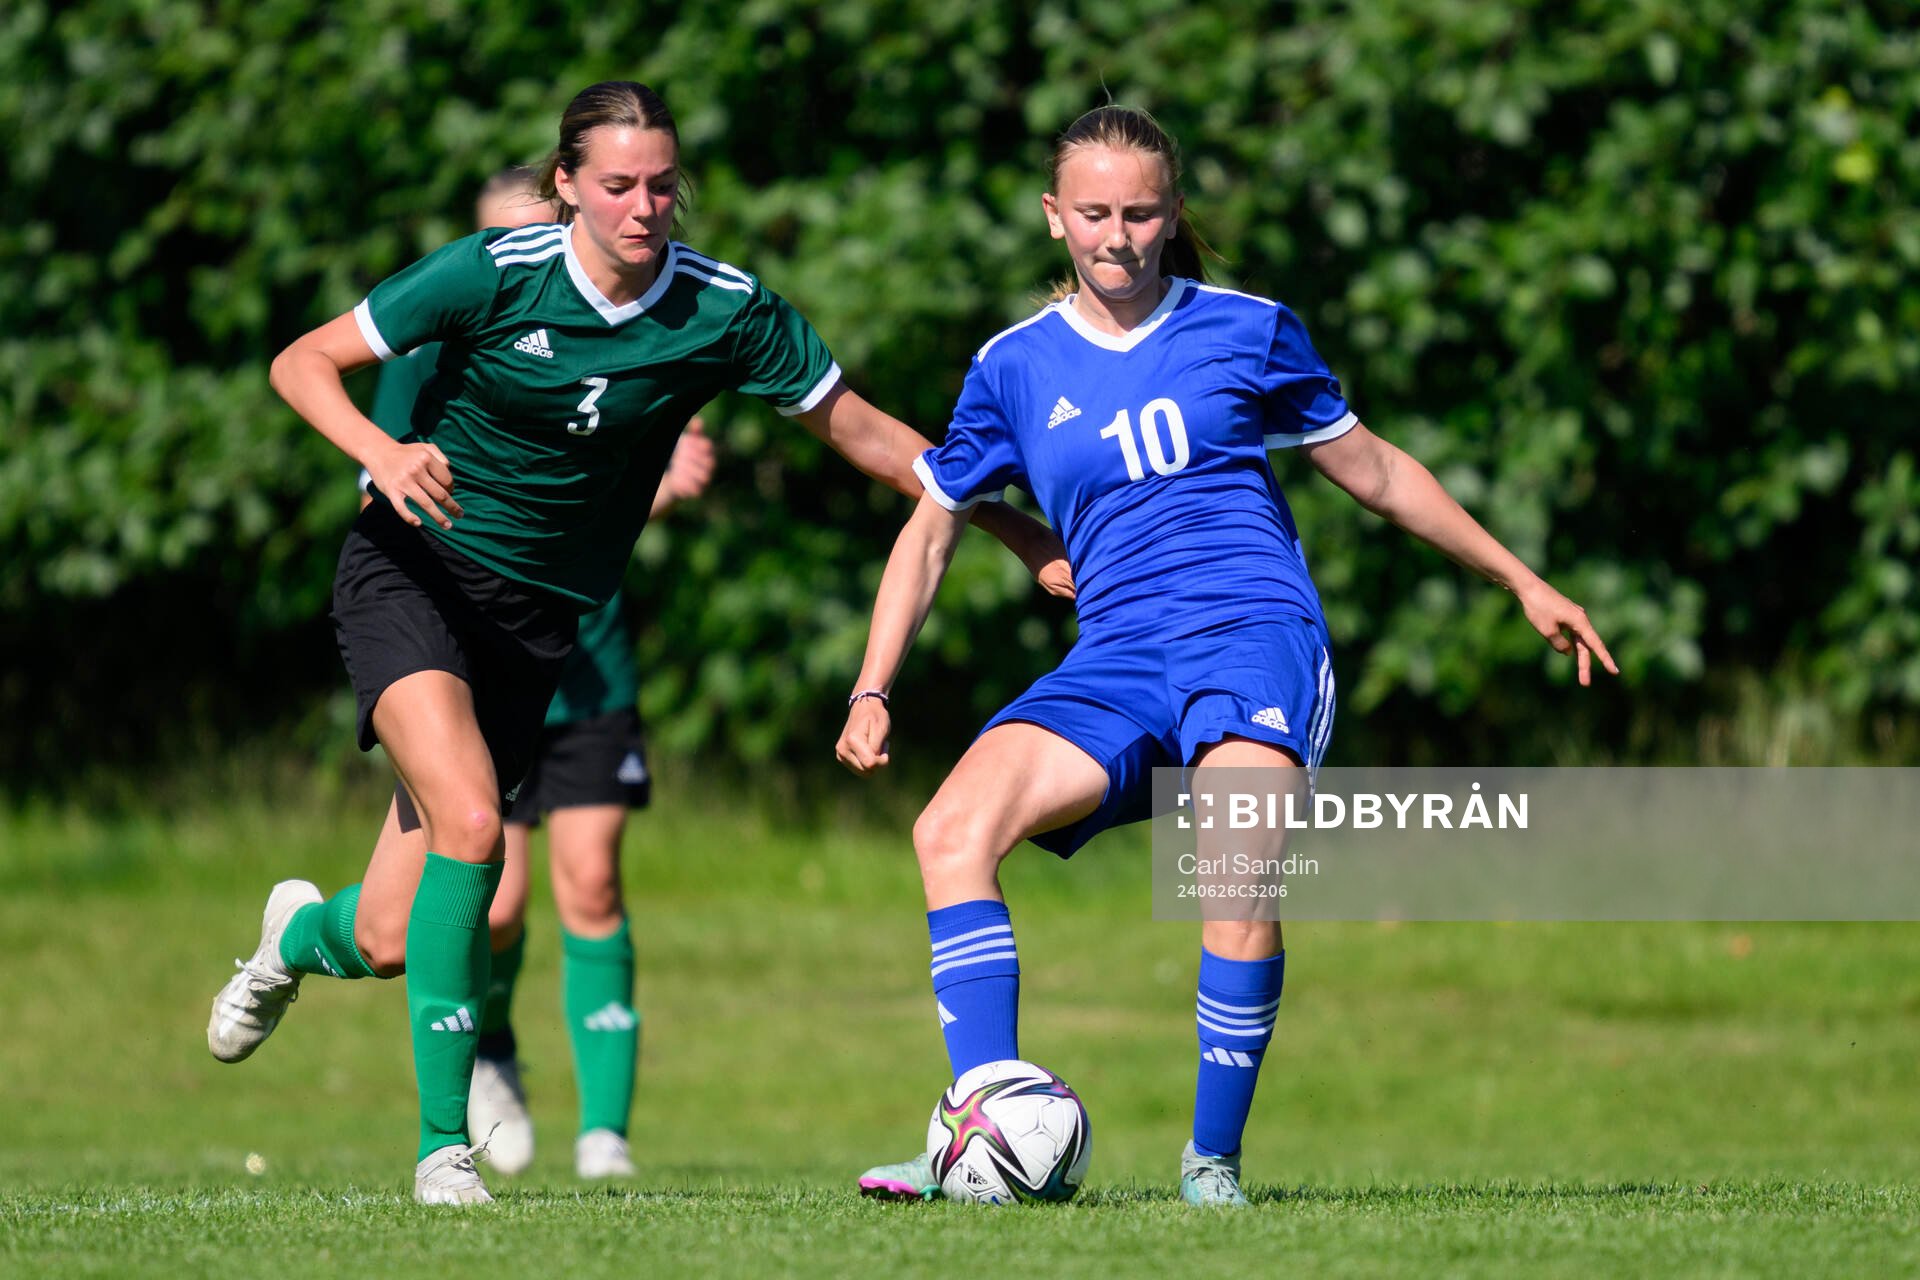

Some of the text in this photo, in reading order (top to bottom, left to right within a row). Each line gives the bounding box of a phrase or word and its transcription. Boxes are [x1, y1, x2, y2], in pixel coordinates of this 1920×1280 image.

[514, 341, 554, 359] adidas
[567, 376, 609, 436] 3
[1047, 407, 1082, 429] adidas
[1100, 397, 1190, 482] 10
[1251, 714, 1290, 734] adidas
